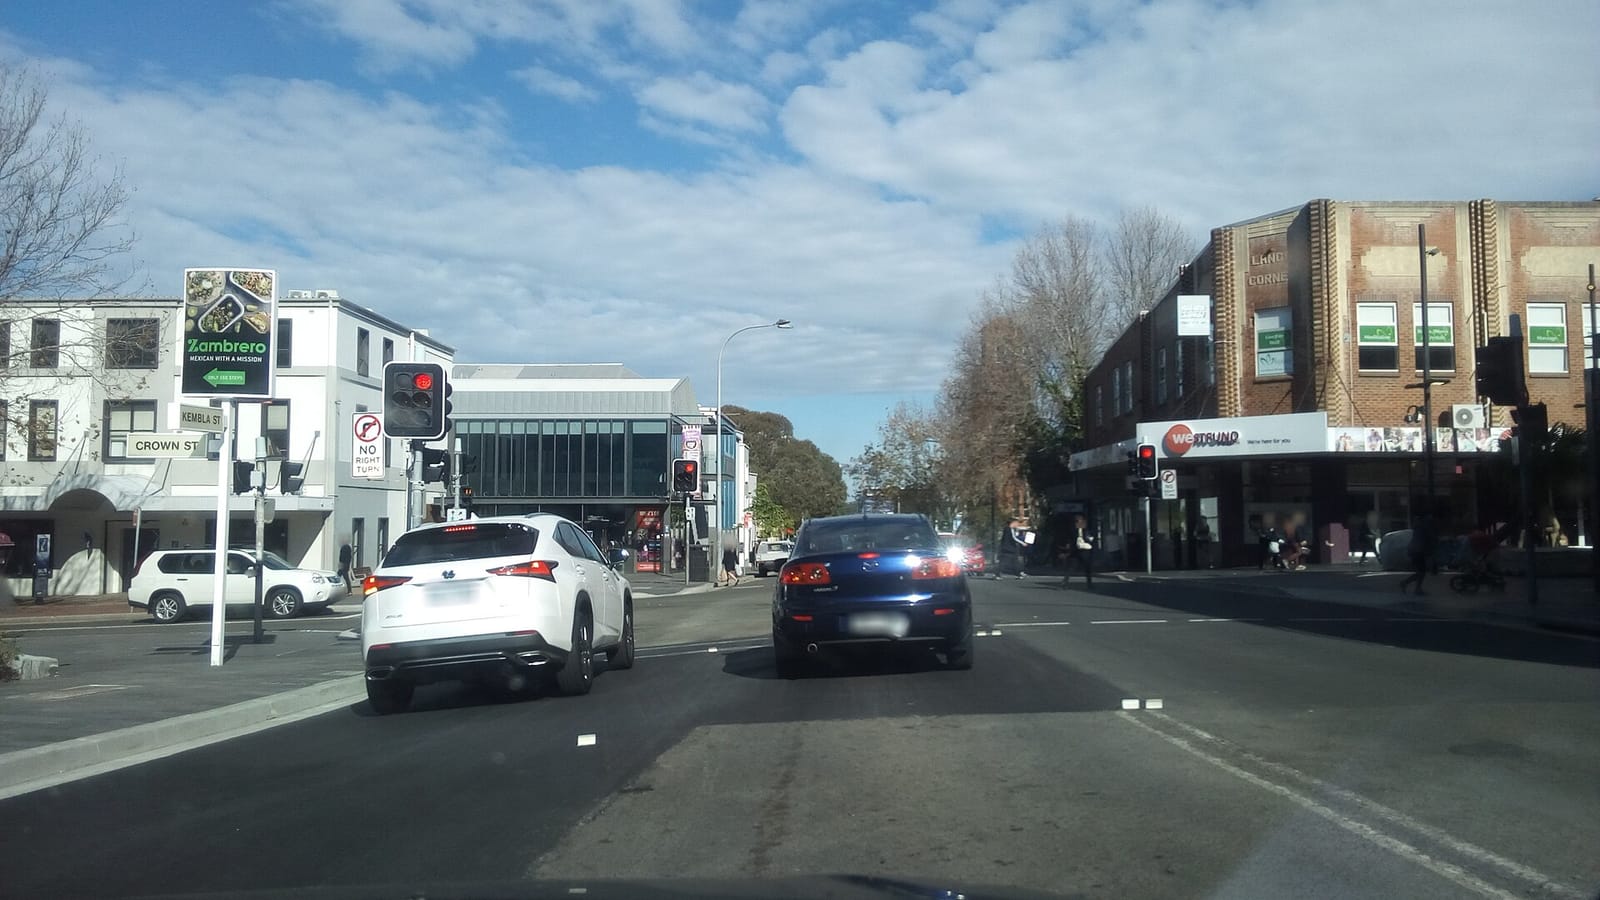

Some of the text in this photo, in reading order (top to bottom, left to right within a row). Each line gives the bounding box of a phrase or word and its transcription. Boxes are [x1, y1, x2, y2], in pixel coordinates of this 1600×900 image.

[1249, 272, 1288, 286] CORNE
[187, 339, 266, 354] Zambrero
[182, 412, 221, 425] KEMBLA ST
[135, 441, 199, 451] CROWN ST
[359, 445, 377, 455] NO
[355, 456, 380, 464] RIGHT
